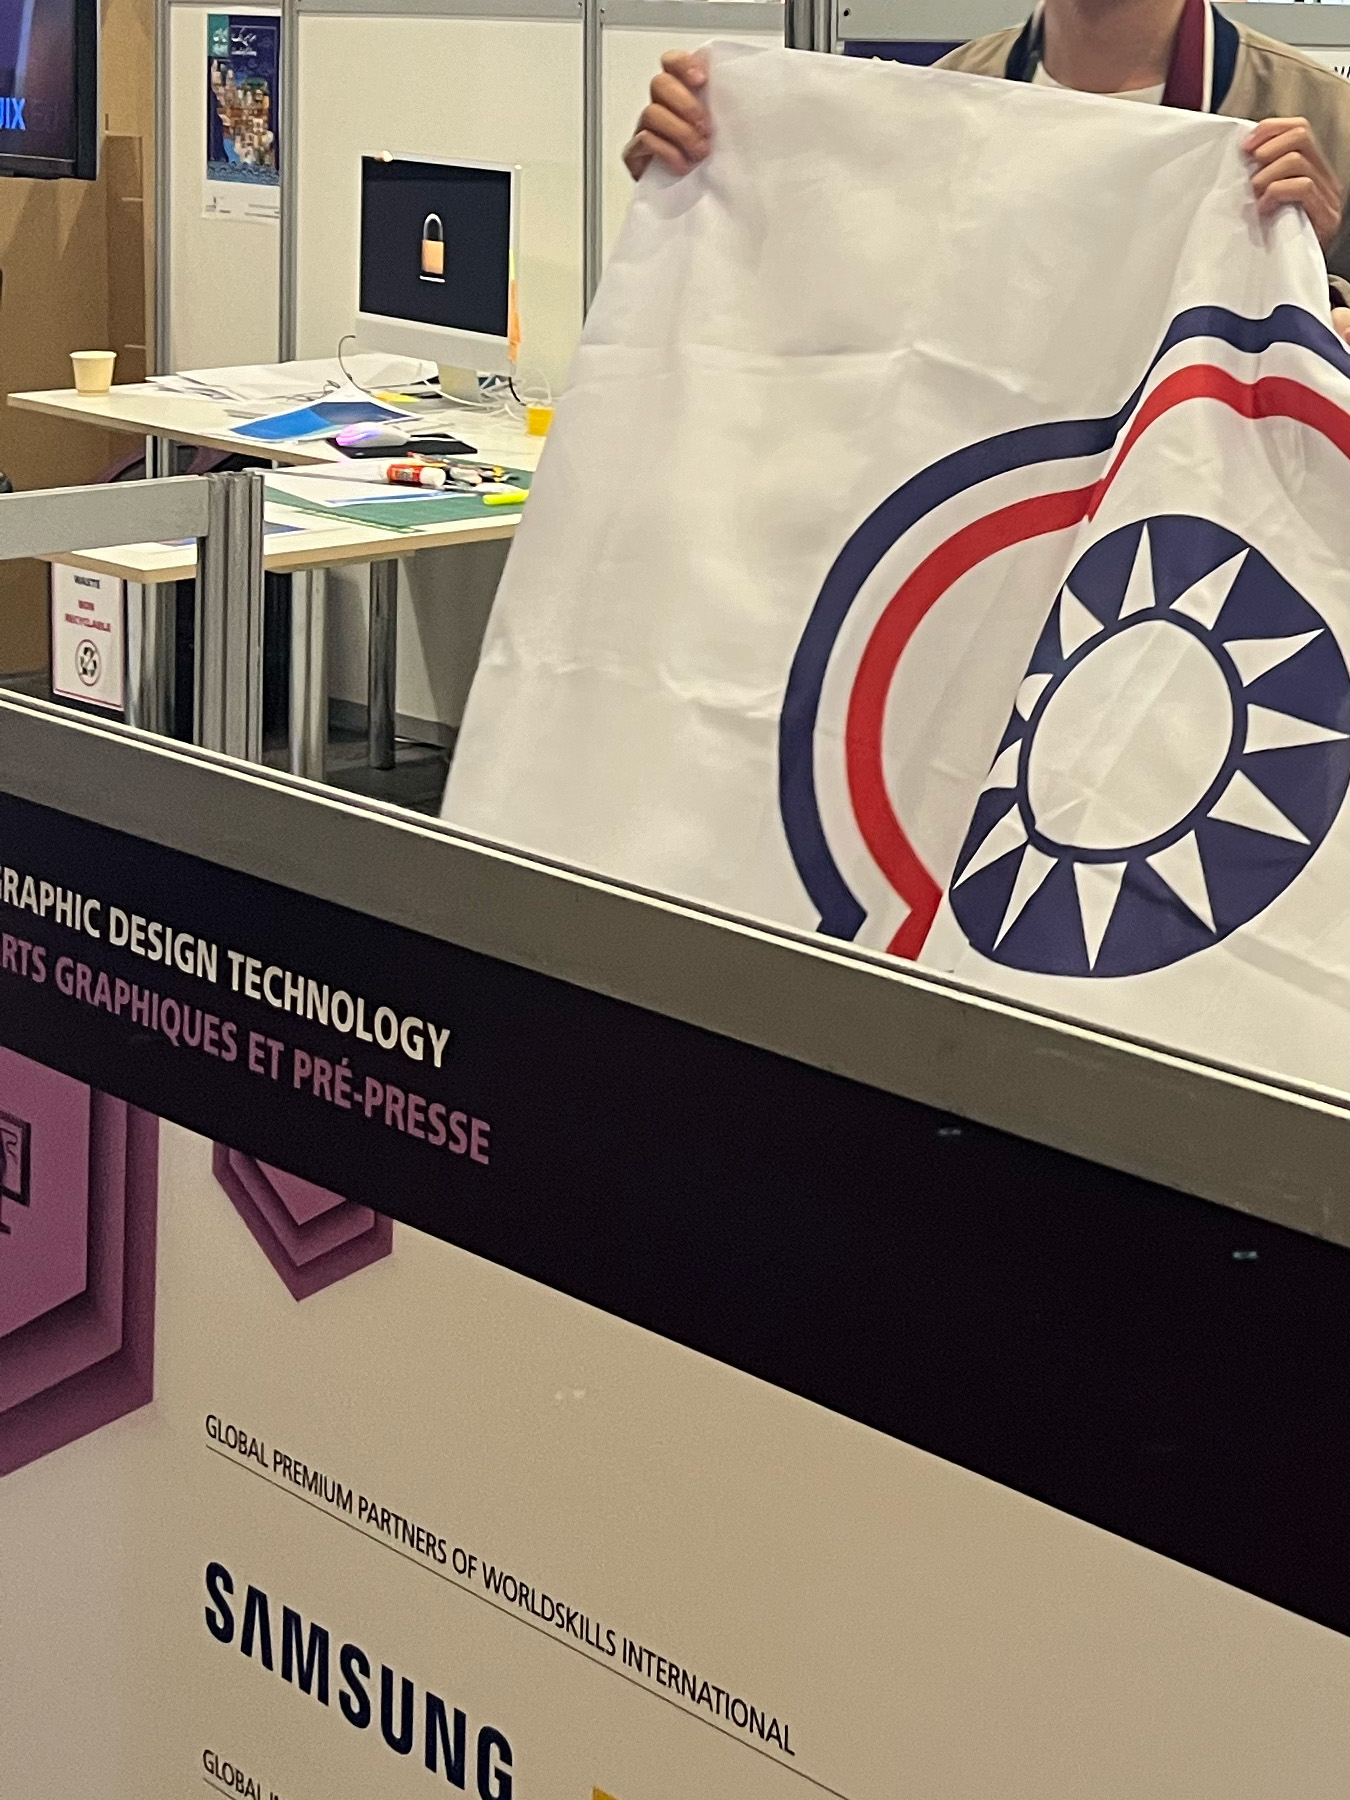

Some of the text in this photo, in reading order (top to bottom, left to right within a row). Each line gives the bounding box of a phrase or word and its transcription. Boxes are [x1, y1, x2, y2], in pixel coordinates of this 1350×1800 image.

[0, 866, 450, 1068] RAPHIC DESIGN TECHNOLOGY
[0, 932, 491, 1164] RTS GRAPHIQUES ET PRÉ-PRESSE
[204, 1561, 513, 1800] SAMSUNG
[205, 1414, 795, 1756] GLOBAL PREMIUM PARTNERS OF WORLDSKILLS INTERNATIONAL
